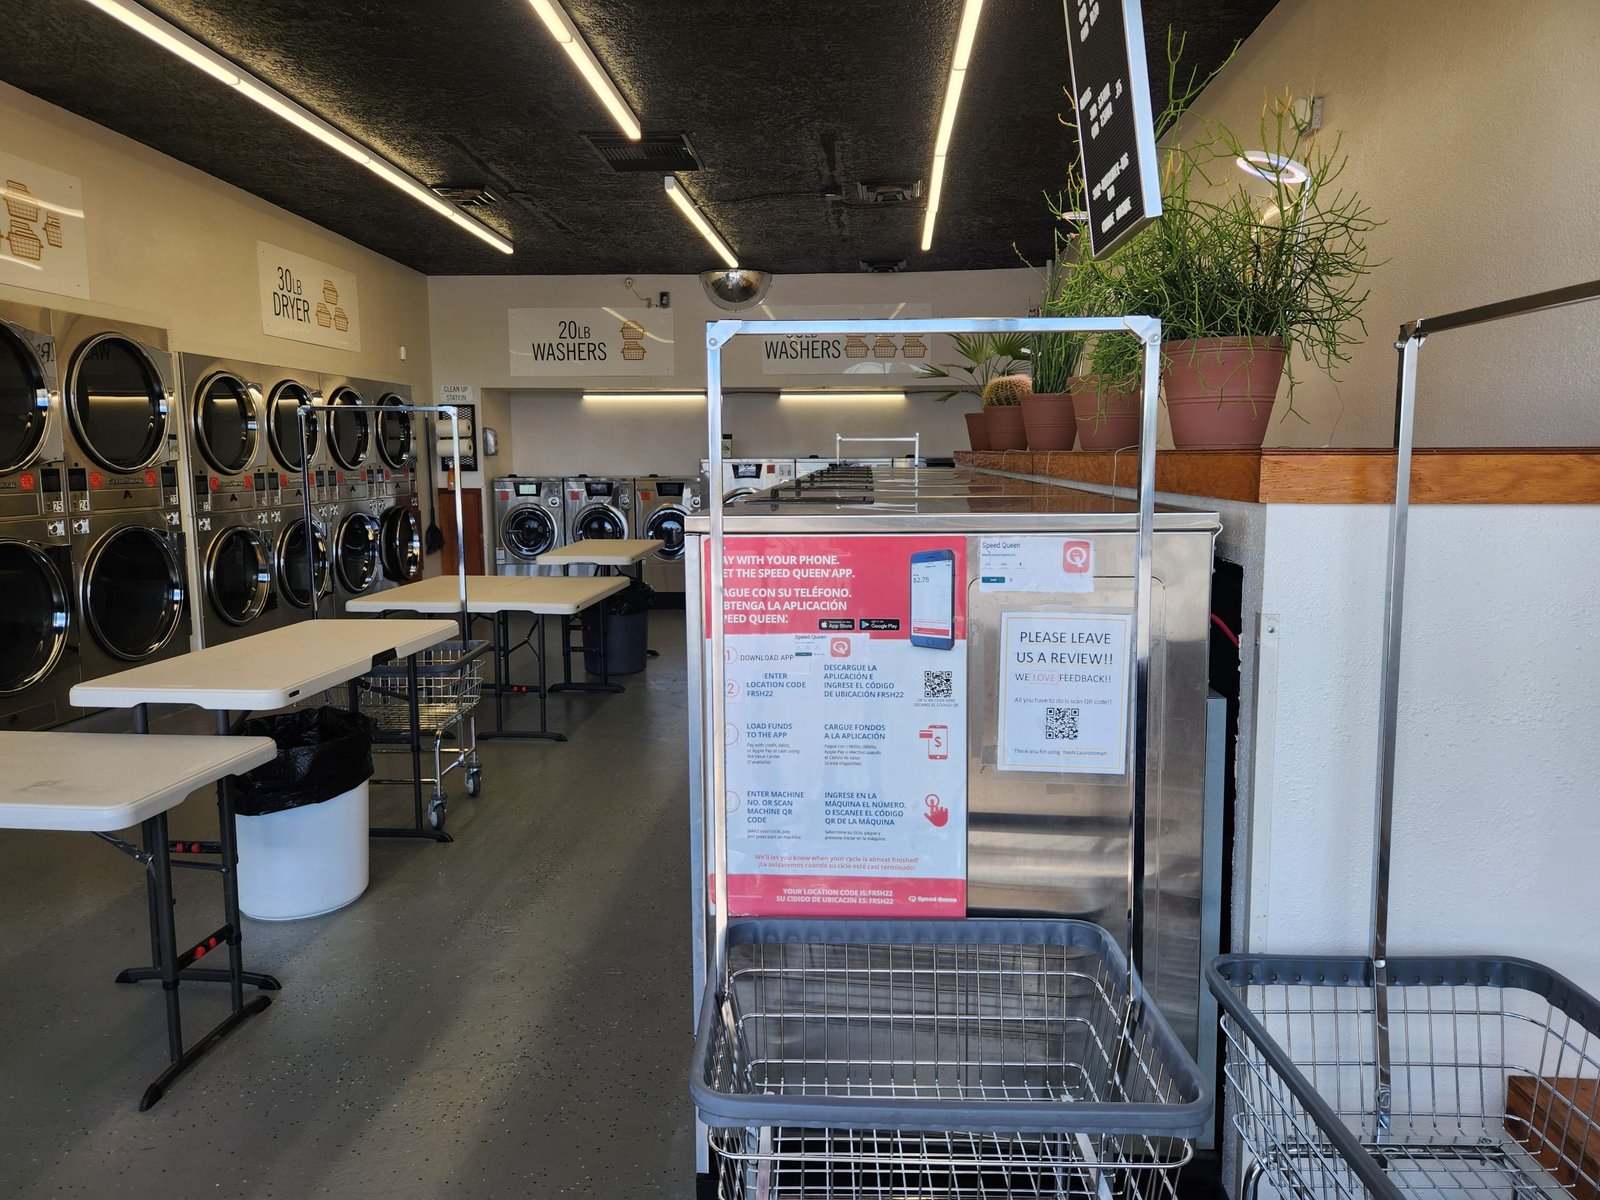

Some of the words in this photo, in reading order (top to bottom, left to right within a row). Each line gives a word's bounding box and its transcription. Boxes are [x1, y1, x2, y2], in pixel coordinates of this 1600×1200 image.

[277, 266, 302, 295] 30LB
[273, 292, 311, 324] DRYER
[559, 321, 591, 339] 20LB
[532, 342, 607, 361] WASHERS
[765, 340, 841, 359] WASHERS
[982, 541, 1000, 549] Speed
[1002, 541, 1021, 549] Queen
[723, 555, 734, 565] AY
[737, 556, 765, 565] WITH
[767, 556, 797, 565] YOUR
[800, 556, 840, 565] PHONE.
[723, 569, 734, 578] ET
[736, 569, 756, 578] THE
[758, 569, 790, 578] SPEED
[723, 588, 749, 597] AGUE
[752, 588, 776, 597] CON
[778, 588, 792, 597] SU
[794, 586, 852, 597] TELÉFONO.
[724, 601, 766, 611] BTENGA
[768, 601, 781, 611] LA
[783, 599, 847, 611] APLICACIÓN
[724, 614, 746, 624] PEED
[1020, 632, 1066, 643] PLEASE
[1071, 632, 1111, 644] LEAVE
[1016, 652, 1034, 663] US
[1037, 652, 1047, 663] A
[1051, 653, 1113, 665] REVIEW!!
[824, 672, 867, 680] APLICACIÓN
[1015, 673, 1029, 681] WE
[1033, 674, 1056, 682] LOVE
[1059, 674, 1111, 683] FEEDBACK!!
[727, 683, 735, 694] 2
[865, 681, 894, 689] CÓDIGO
[835, 690, 876, 698] UBICACIÓN
[842, 732, 885, 740] APLICACIÓN
[825, 800, 860, 809] MÁQUINA
[872, 800, 907, 809] NÚMERO,
[875, 809, 904, 817] CÓDIGO
[825, 818, 835, 826] QR
[859, 818, 895, 826] MÁQUINA
